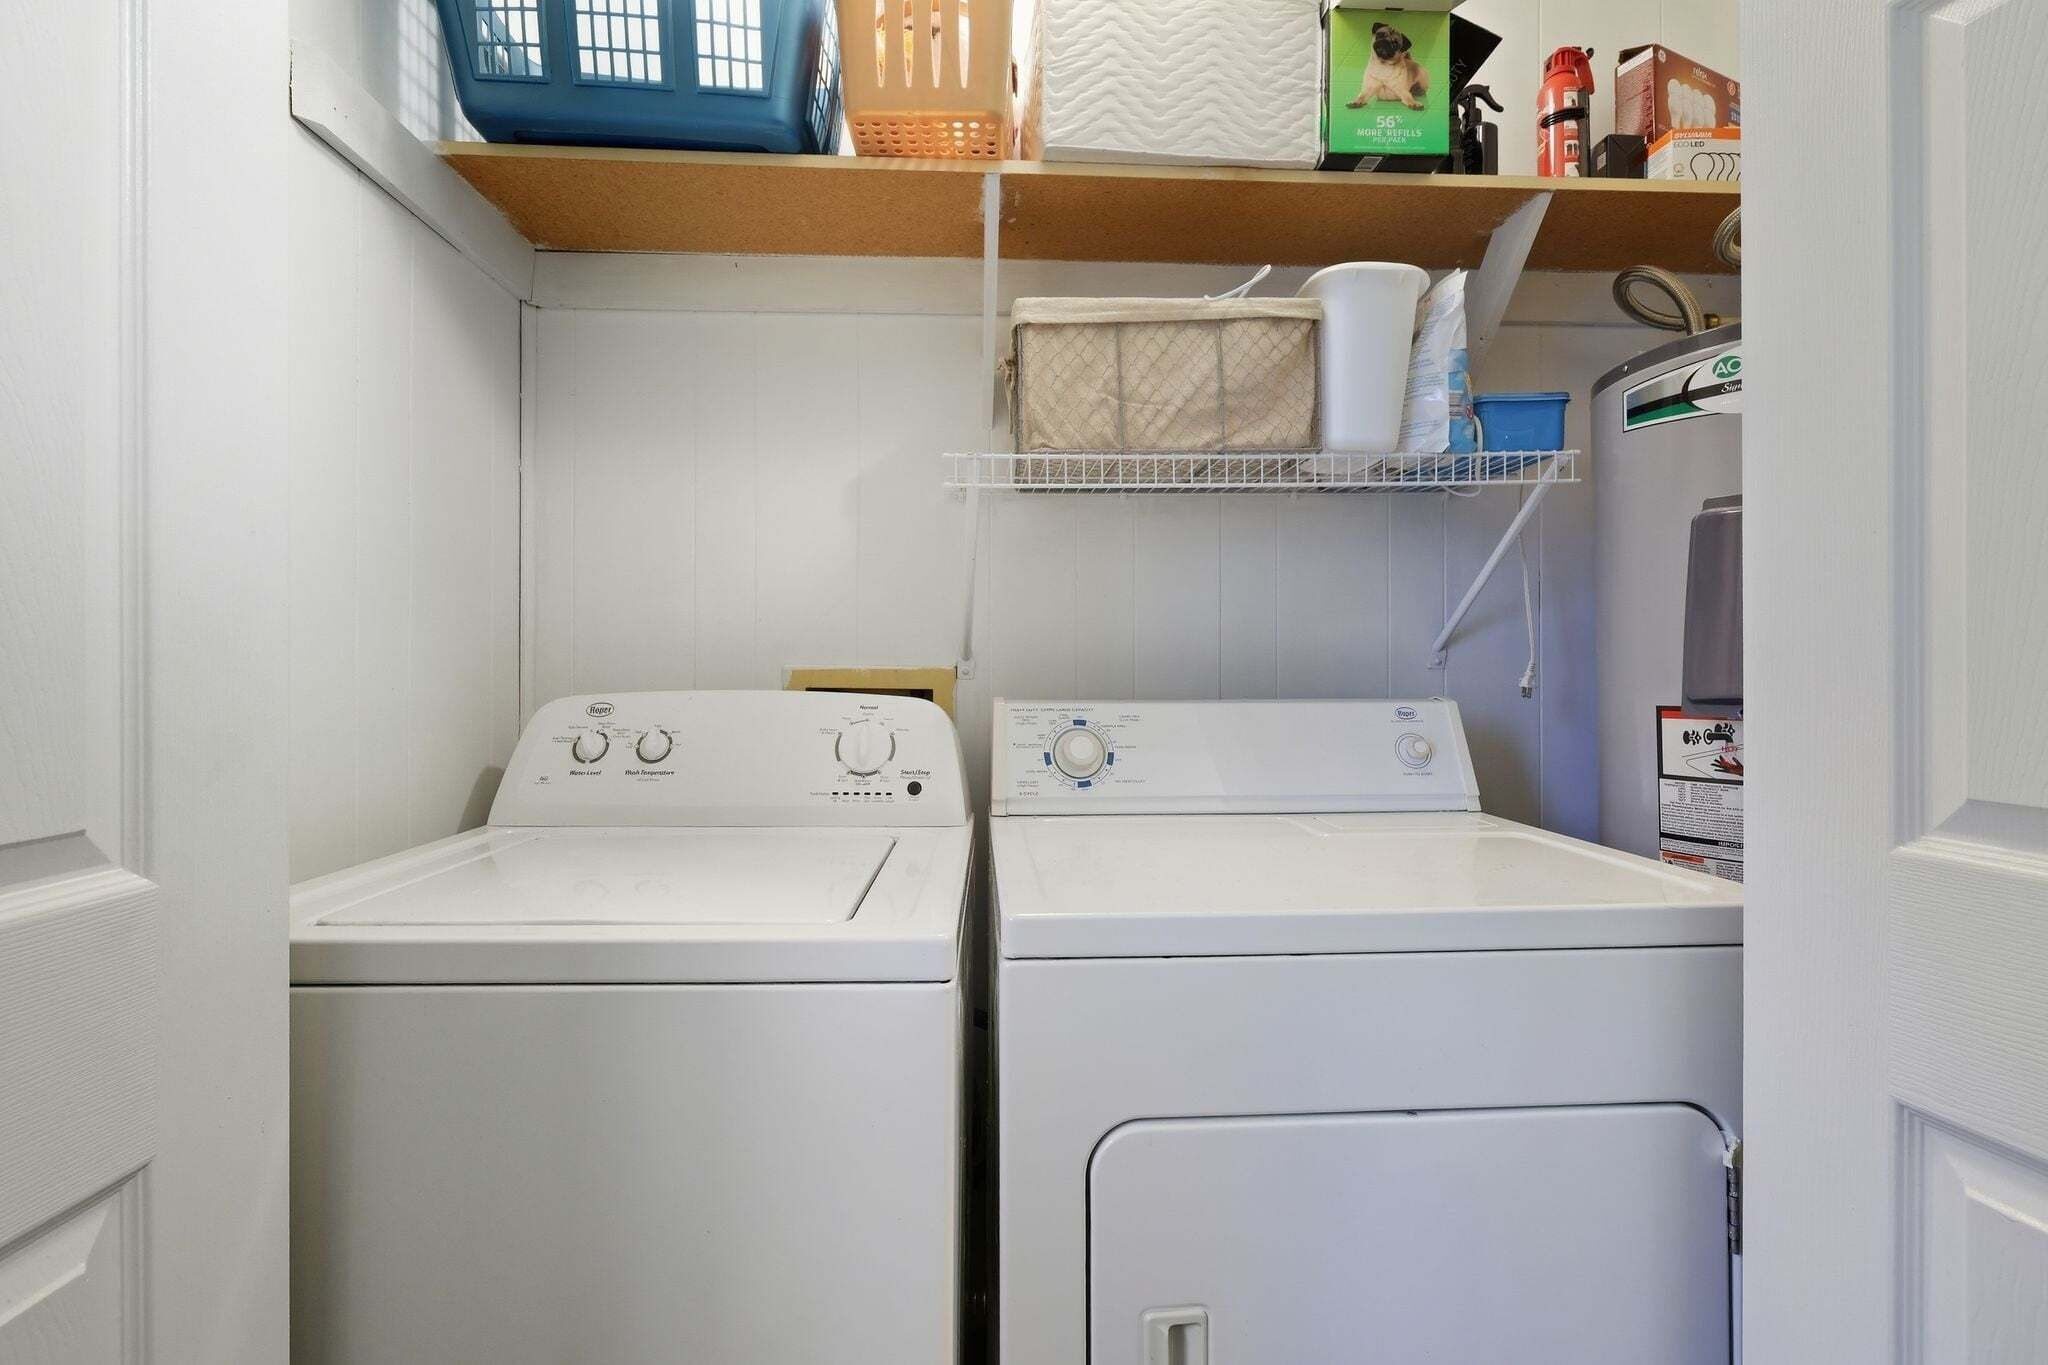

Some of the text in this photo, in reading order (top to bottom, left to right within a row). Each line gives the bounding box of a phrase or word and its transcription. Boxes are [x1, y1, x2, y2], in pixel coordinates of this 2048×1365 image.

[1356, 128, 1423, 137] MORE REFILLS
[569, 769, 586, 777] Water
